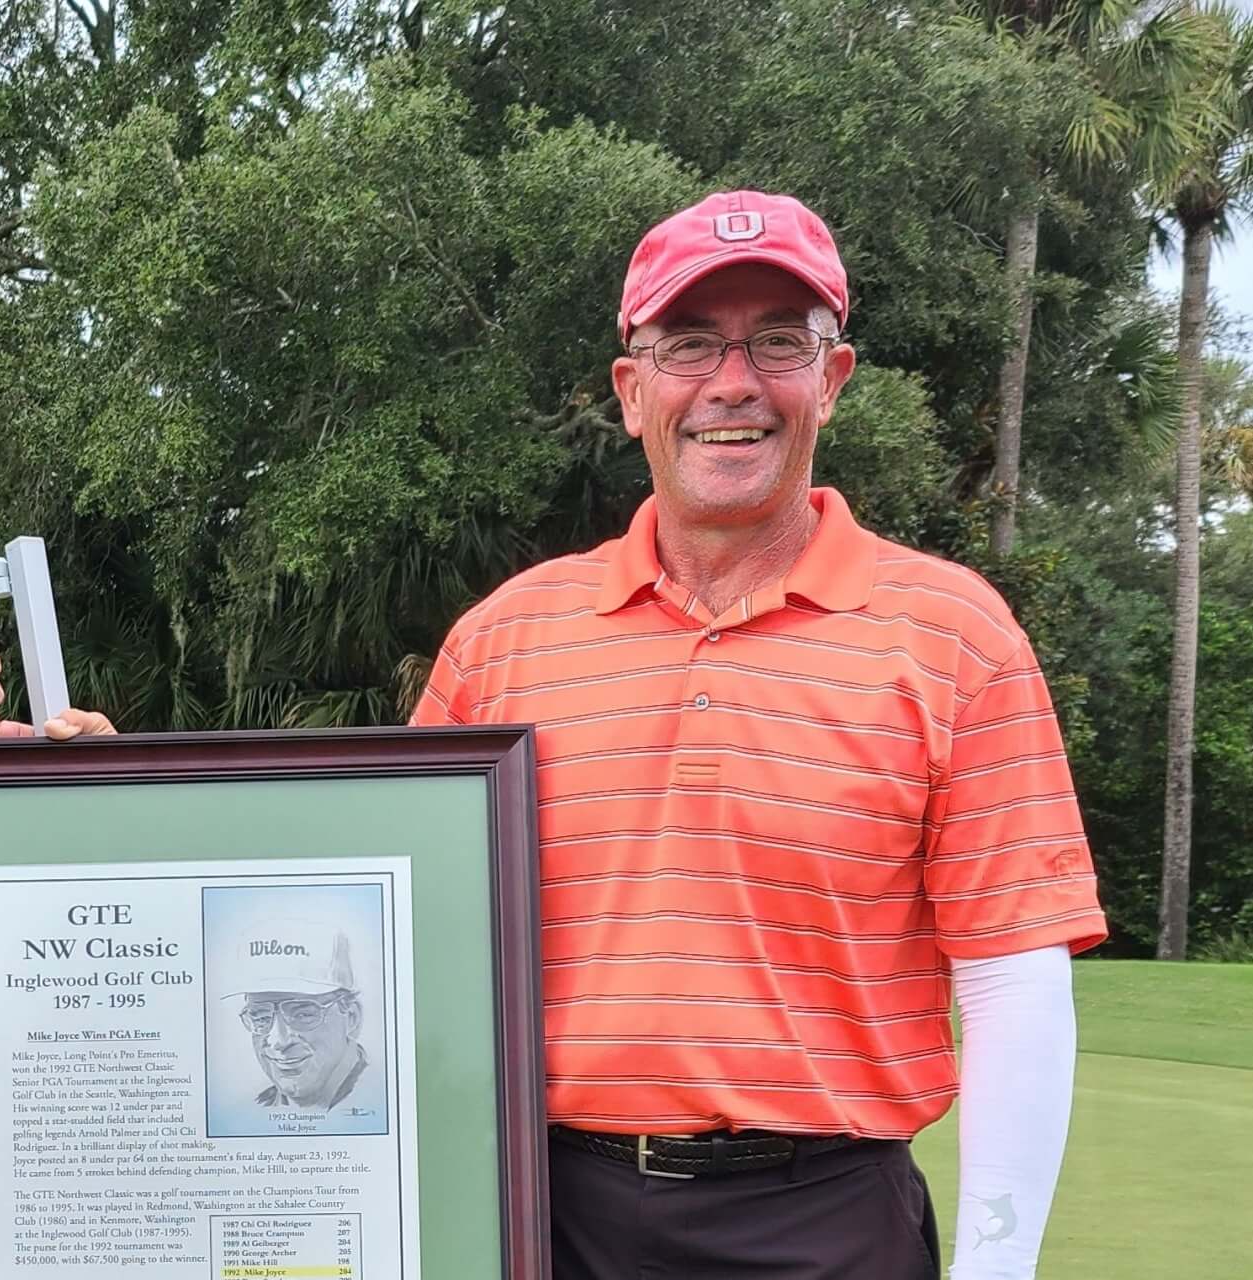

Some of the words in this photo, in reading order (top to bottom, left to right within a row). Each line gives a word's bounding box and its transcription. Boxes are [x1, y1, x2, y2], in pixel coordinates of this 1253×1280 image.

[713, 211, 765, 242] O
[68, 905, 132, 925] GTE
[23, 939, 76, 959] NW
[86, 937, 179, 958] Classic
[6, 973, 98, 992] Inglewood
[105, 972, 144, 986] Golf
[151, 971, 192, 985] Club
[54, 995, 90, 1009] 1987
[110, 994, 146, 1008] 1995
[28, 1032, 51, 1040] Mike
[55, 1032, 79, 1041] Joyce
[82, 1031, 106, 1039] Wins
[110, 1030, 131, 1038] PGA
[135, 1030, 160, 1038] Event
[12, 1052, 34, 1060] Mike
[37, 1052, 62, 1062] Joyce,
[65, 1051, 87, 1061] Long
[89, 1051, 117, 1059] Point's
[137, 1050, 178, 1059] Emeritus,
[33, 1065, 47, 1073] the
[50, 1065, 70, 1073] 1992
[73, 1064, 95, 1072] GTE
[98, 1064, 142, 1072] Northwest
[145, 1063, 174, 1071] Classic
[12, 1078, 39, 1087] Senior
[43, 1078, 62, 1086] PGA
[65, 1077, 117, 1085] Tournament
[147, 1076, 191, 1086] Inglewood
[13, 1091, 33, 1099] Golf
[35, 1091, 56, 1099] Club
[86, 1090, 116, 1098] Seattle,
[119, 1090, 169, 1100] Washington
[13, 1104, 28, 1112] His
[30, 1104, 65, 1114] winning
[110, 1103, 120, 1111] 12
[123, 1103, 148, 1111] under
[151, 1104, 165, 1112] par
[167, 1102, 182, 1110] and
[13, 1118, 43, 1127] topped
[52, 1116, 104, 1125] star-studded
[107, 1116, 126, 1124] field
[128, 1115, 145, 1123] that
[148, 1115, 183, 1123] included
[288, 1113, 325, 1121] Champion
[13, 1130, 43, 1141] golfing
[45, 1130, 76, 1139] legends
[79, 1129, 109, 1137] Arnold
[112, 1129, 140, 1137] Palmer
[143, 1128, 158, 1136] and
[162, 1128, 177, 1136] Chi
[180, 1127, 196, 1135] Chi
[298, 1124, 316, 1132] Joyce
[14, 1143, 59, 1153] Rodriguez.
[81, 1142, 114, 1150] brilliant
[117, 1141, 146, 1151] display
[149, 1141, 159, 1149] of
[25, 1230, 38, 1238] the
[41, 1230, 86, 1240] Inglewood
[89, 1229, 109, 1237] Golf
[111, 1229, 132, 1237] Club
[135, 1228, 191, 1238] (1987-1995).
[15, 1243, 31, 1252] The
[34, 1244, 57, 1254] purse
[59, 1242, 71, 1251] for
[74, 1242, 88, 1250] the
[91, 1242, 111, 1250] 1992
[114, 1242, 165, 1250] tournament
[15, 1256, 58, 1265] $450,000,
[84, 1255, 119, 1264] $67,500
[121, 1256, 146, 1265] going
